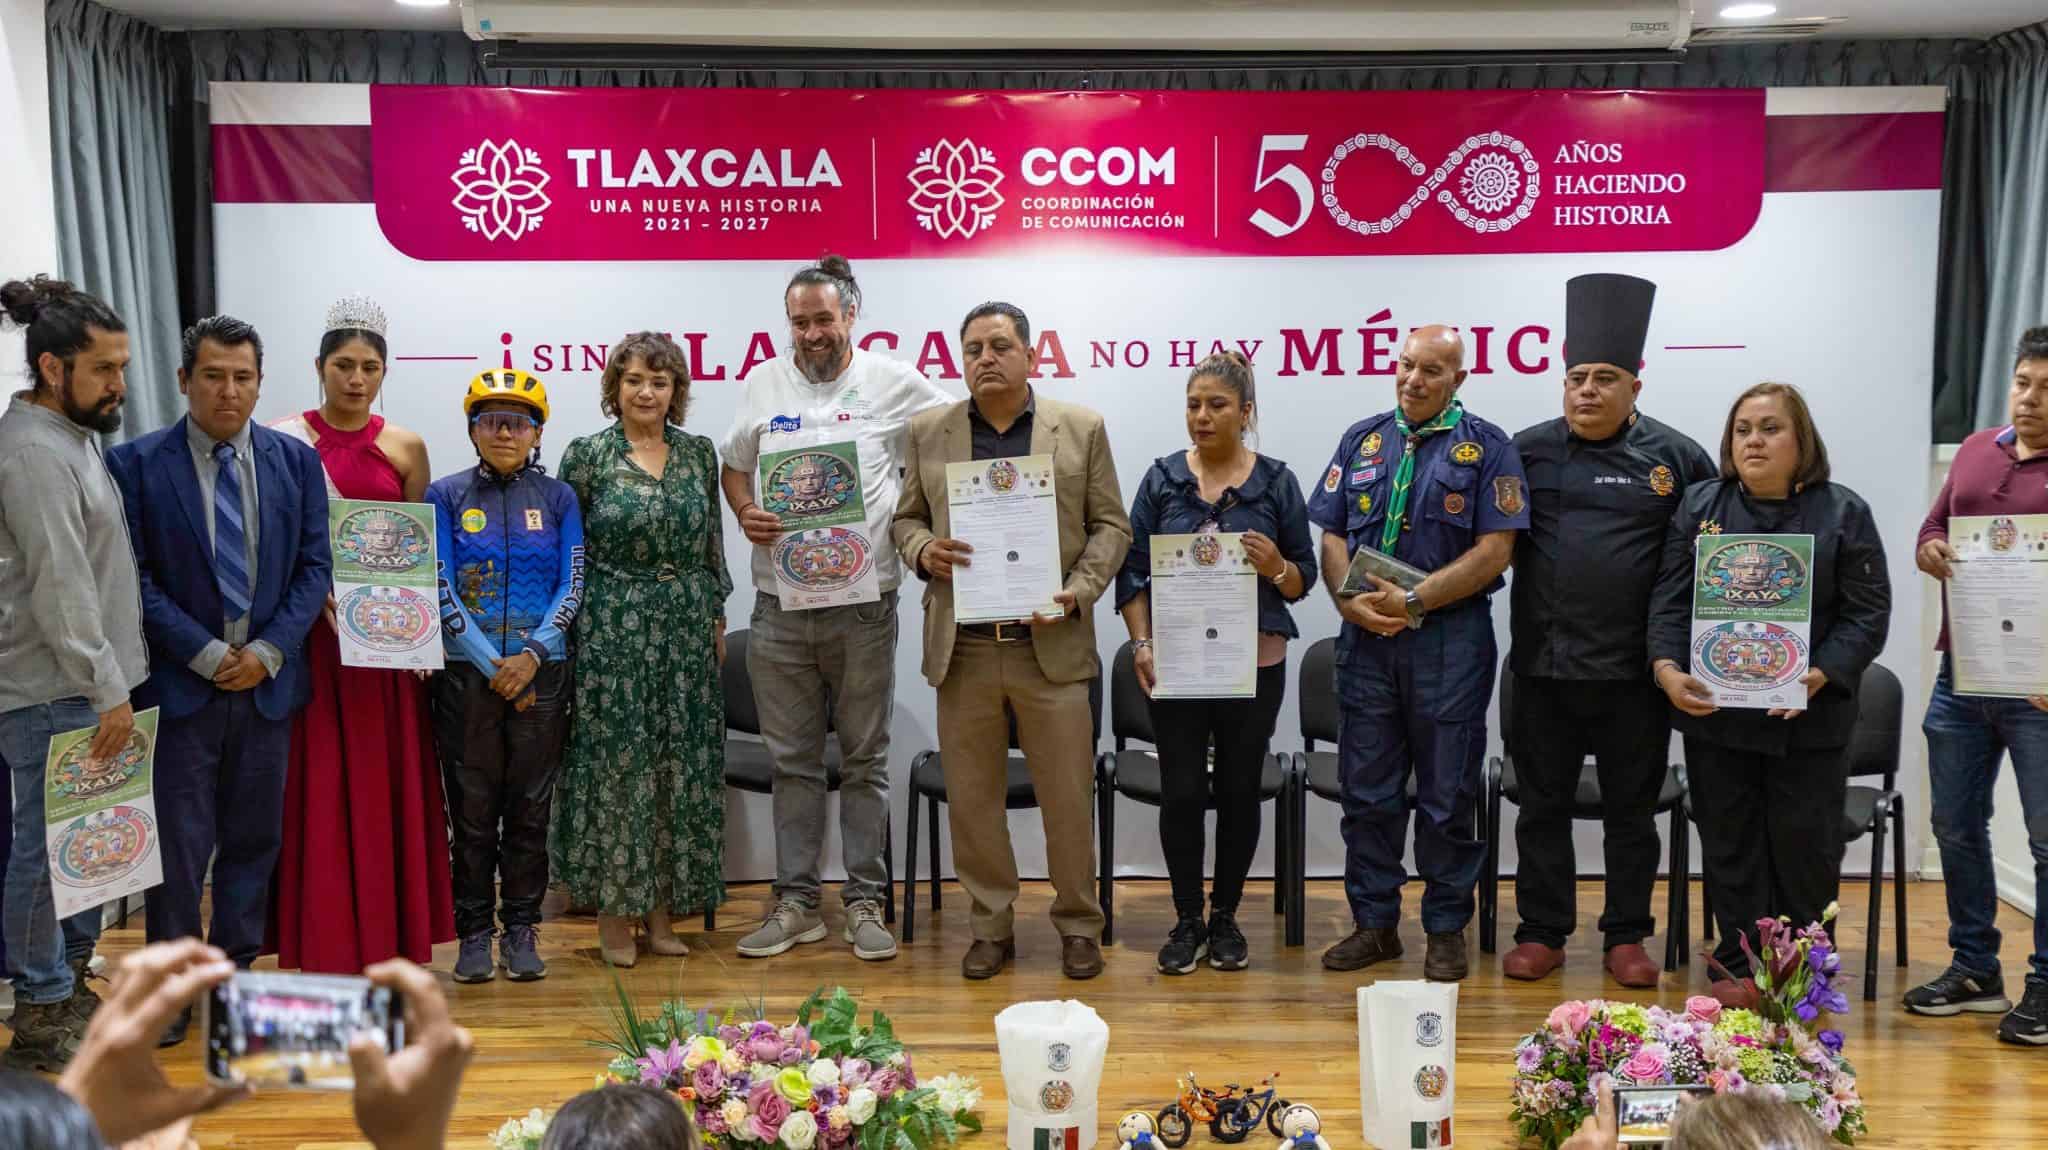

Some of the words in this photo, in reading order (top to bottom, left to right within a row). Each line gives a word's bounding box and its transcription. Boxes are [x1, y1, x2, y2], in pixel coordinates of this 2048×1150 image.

[1554, 140, 1623, 164] AÑOS
[567, 148, 843, 188] TLAXCALA
[1021, 146, 1175, 186] CCOM
[1554, 173, 1686, 195] HACIENDO
[590, 199, 632, 213] UNA
[642, 199, 710, 213] NUEVA
[721, 199, 822, 213] HISTORIA
[1021, 193, 1155, 210] COORDINACIÓN
[644, 217, 690, 231] 2021
[721, 217, 769, 231] 2027
[1021, 214, 1043, 229] DE
[1049, 212, 1185, 229] COMUNICACIÓN
[1554, 205, 1672, 226] HISTORIA
[1091, 340, 1150, 368] NO
[789, 496, 840, 512] IXAYA
[360, 554, 412, 566] IXAYA
[1725, 589, 1782, 601] IXAYA
[75, 771, 128, 794] IXAYA
